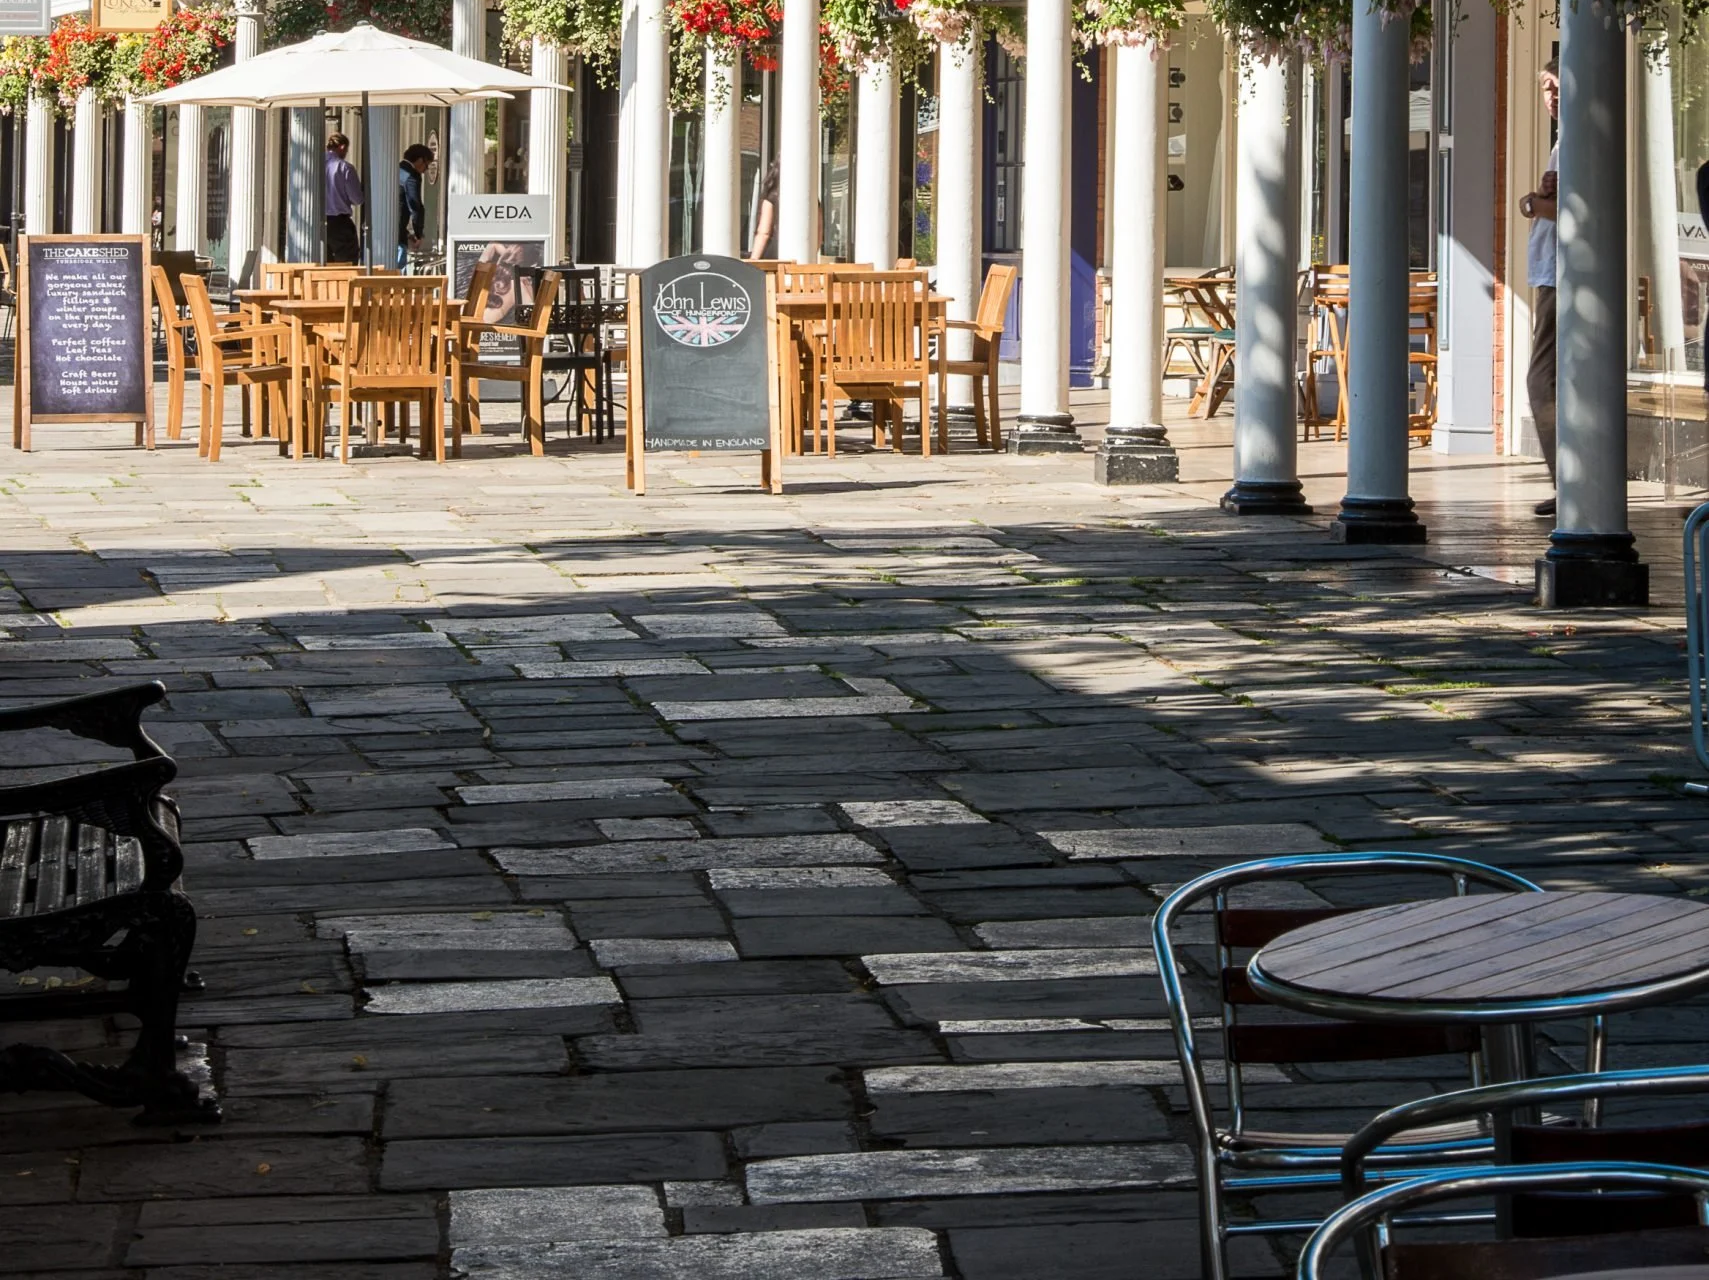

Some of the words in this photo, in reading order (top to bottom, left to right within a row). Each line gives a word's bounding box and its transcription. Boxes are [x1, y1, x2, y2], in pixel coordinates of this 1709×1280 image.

[467, 205, 532, 219] AVEDA
[457, 243, 485, 251] AVEDA
[47, 282, 92, 290] gorgeous
[46, 290, 78, 298] luxury
[654, 283, 695, 311] John
[700, 281, 746, 311] Lewis
[62, 297, 99, 306] fillings
[91, 306, 117, 314] soups
[671, 309, 682, 317] OF
[84, 313, 126, 322] premises
[62, 323, 89, 331] every
[51, 338, 87, 346] Perfect
[90, 337, 127, 346] coffees
[66, 346, 88, 354] Leaf
[61, 370, 87, 379] Craft
[61, 386, 82, 395] Soft
[645, 437, 698, 447] HANDMADE
[702, 438, 712, 447] IN
[715, 437, 765, 448] ENGLAND
